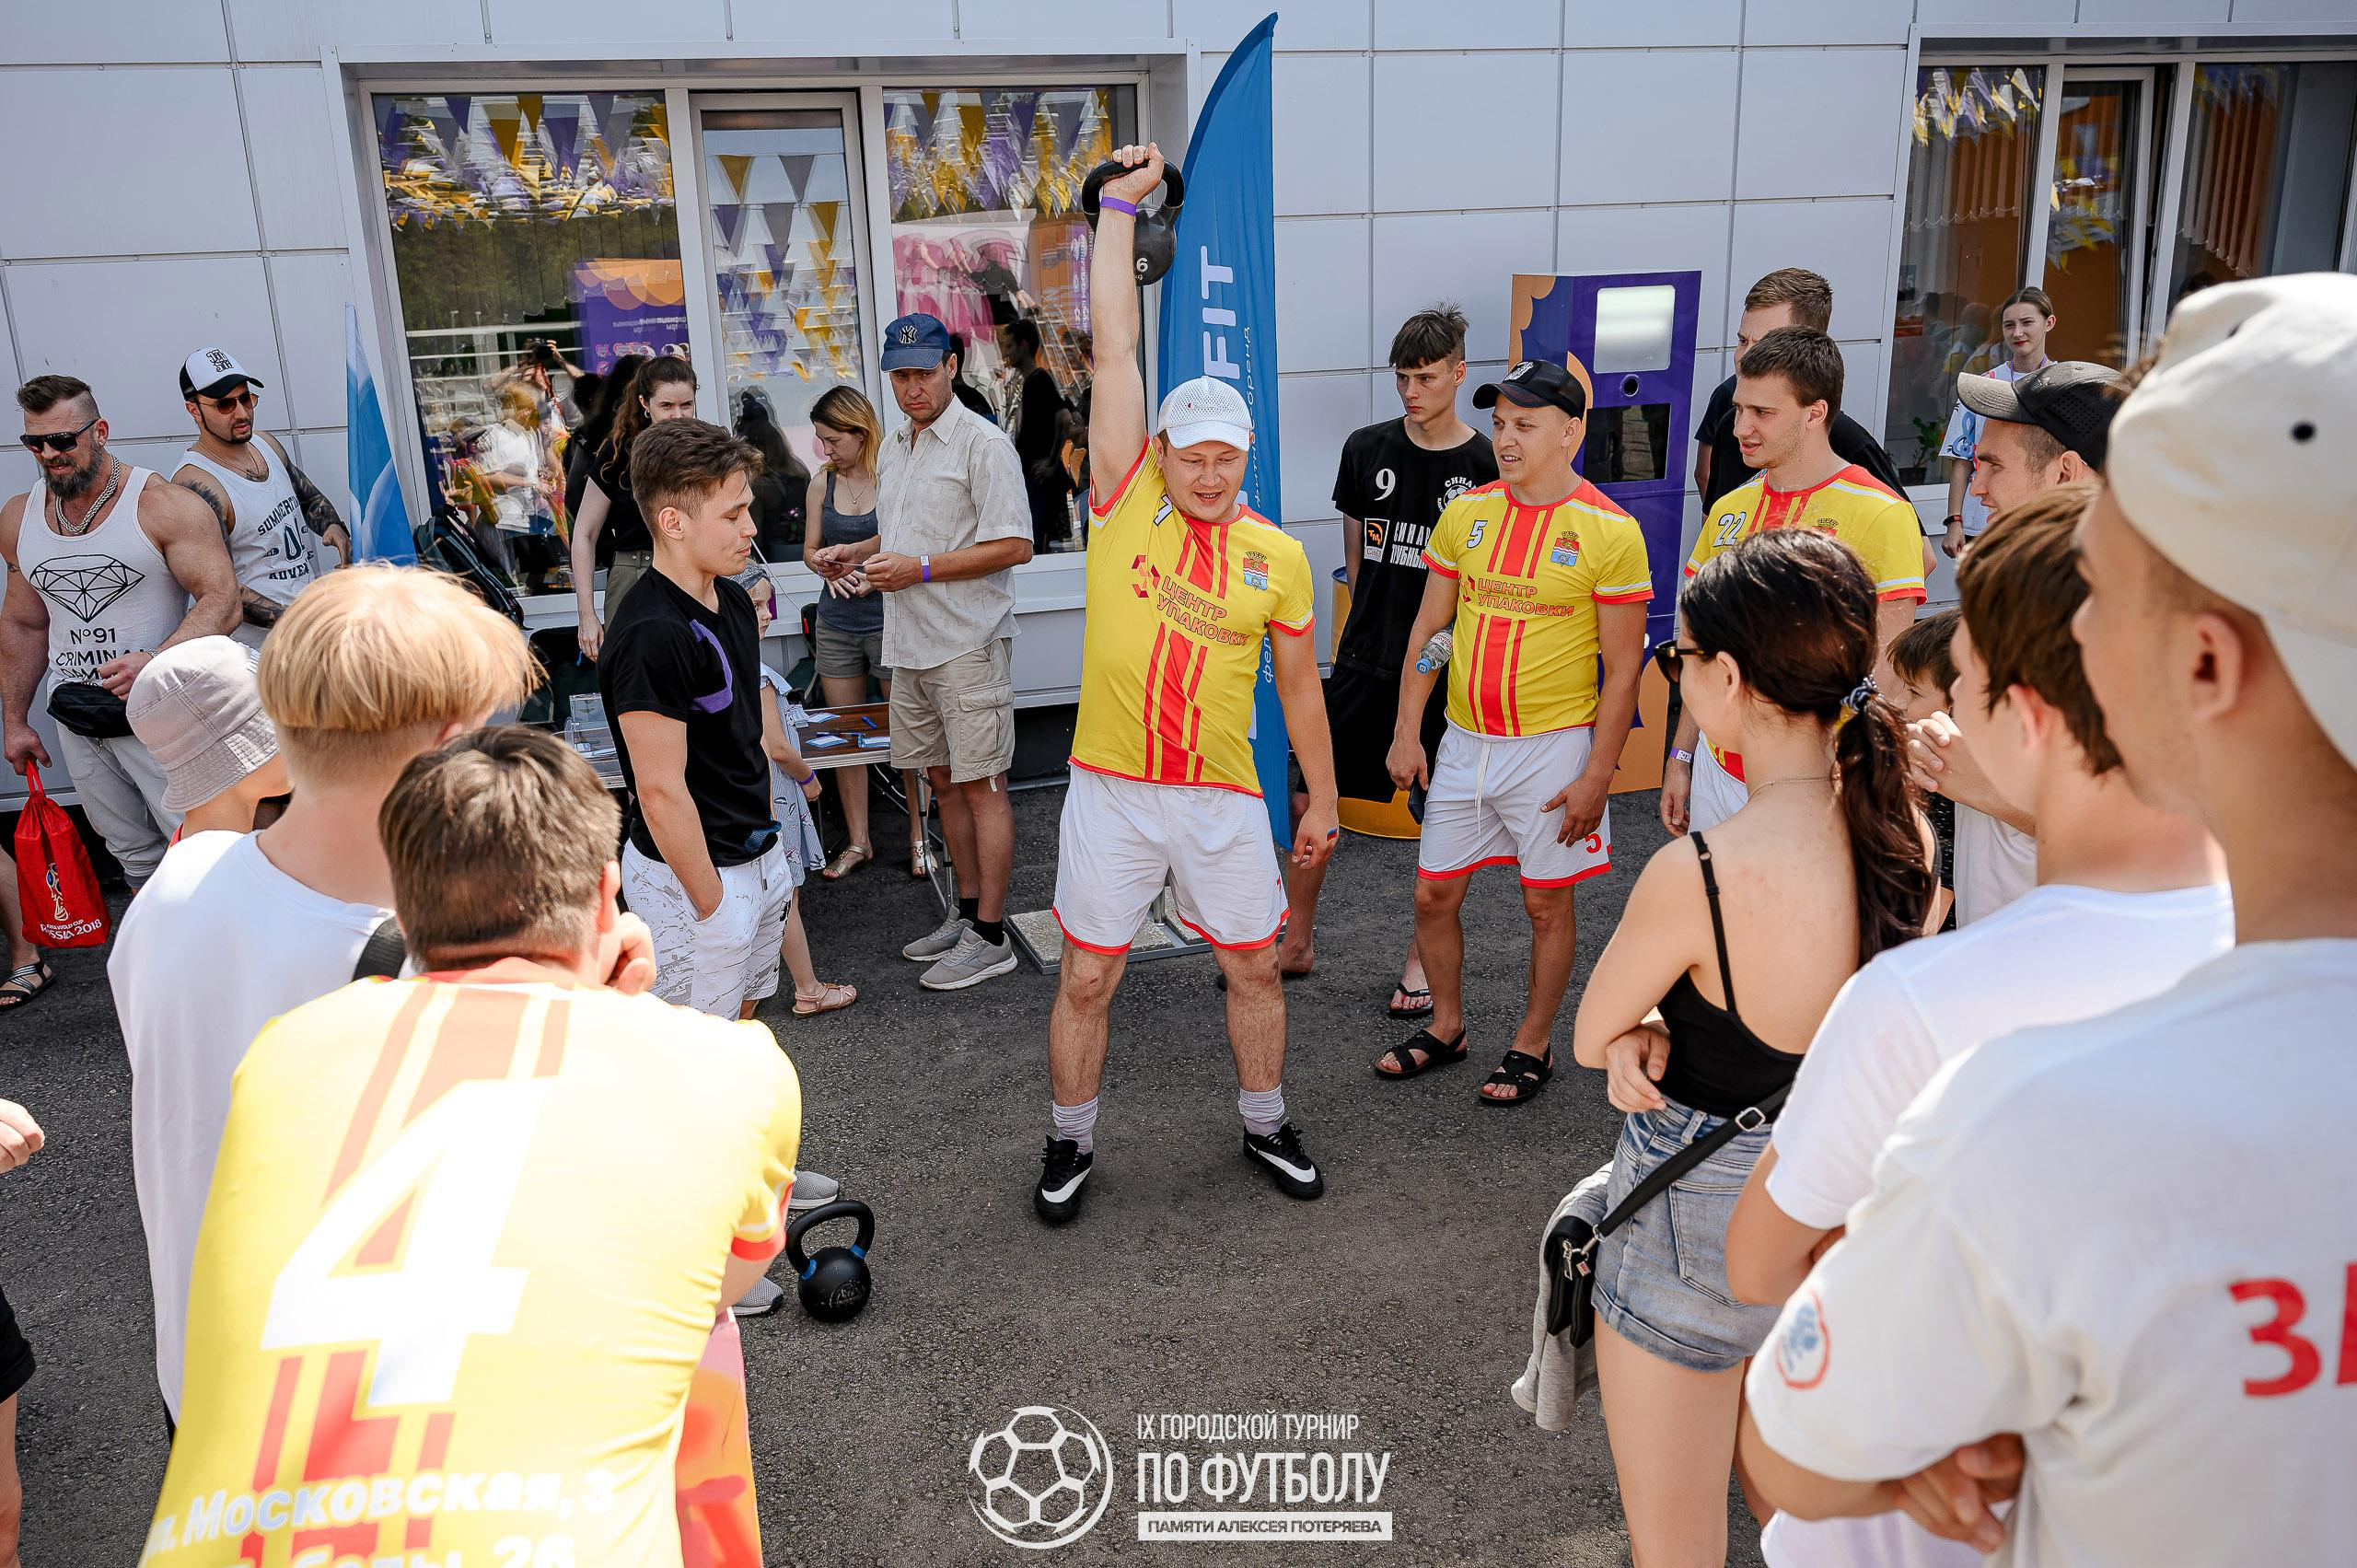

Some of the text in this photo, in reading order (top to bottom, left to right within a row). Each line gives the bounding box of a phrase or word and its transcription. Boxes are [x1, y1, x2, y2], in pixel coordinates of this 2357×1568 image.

[1201, 245, 1240, 380] FIT
[1375, 468, 1397, 501] 9
[1467, 519, 1488, 549] 5
[1713, 512, 1747, 547] 22
[1161, 575, 1227, 621] ЦЕНТР
[1477, 593, 1575, 617] УПАКОВКИ
[1478, 578, 1538, 598] ЦЕНТР
[1156, 593, 1250, 646] УПАКОВКИ
[74, 918, 103, 935] 2018
[258, 1076, 563, 1410] 4
[180, 1471, 575, 1548] Московская,
